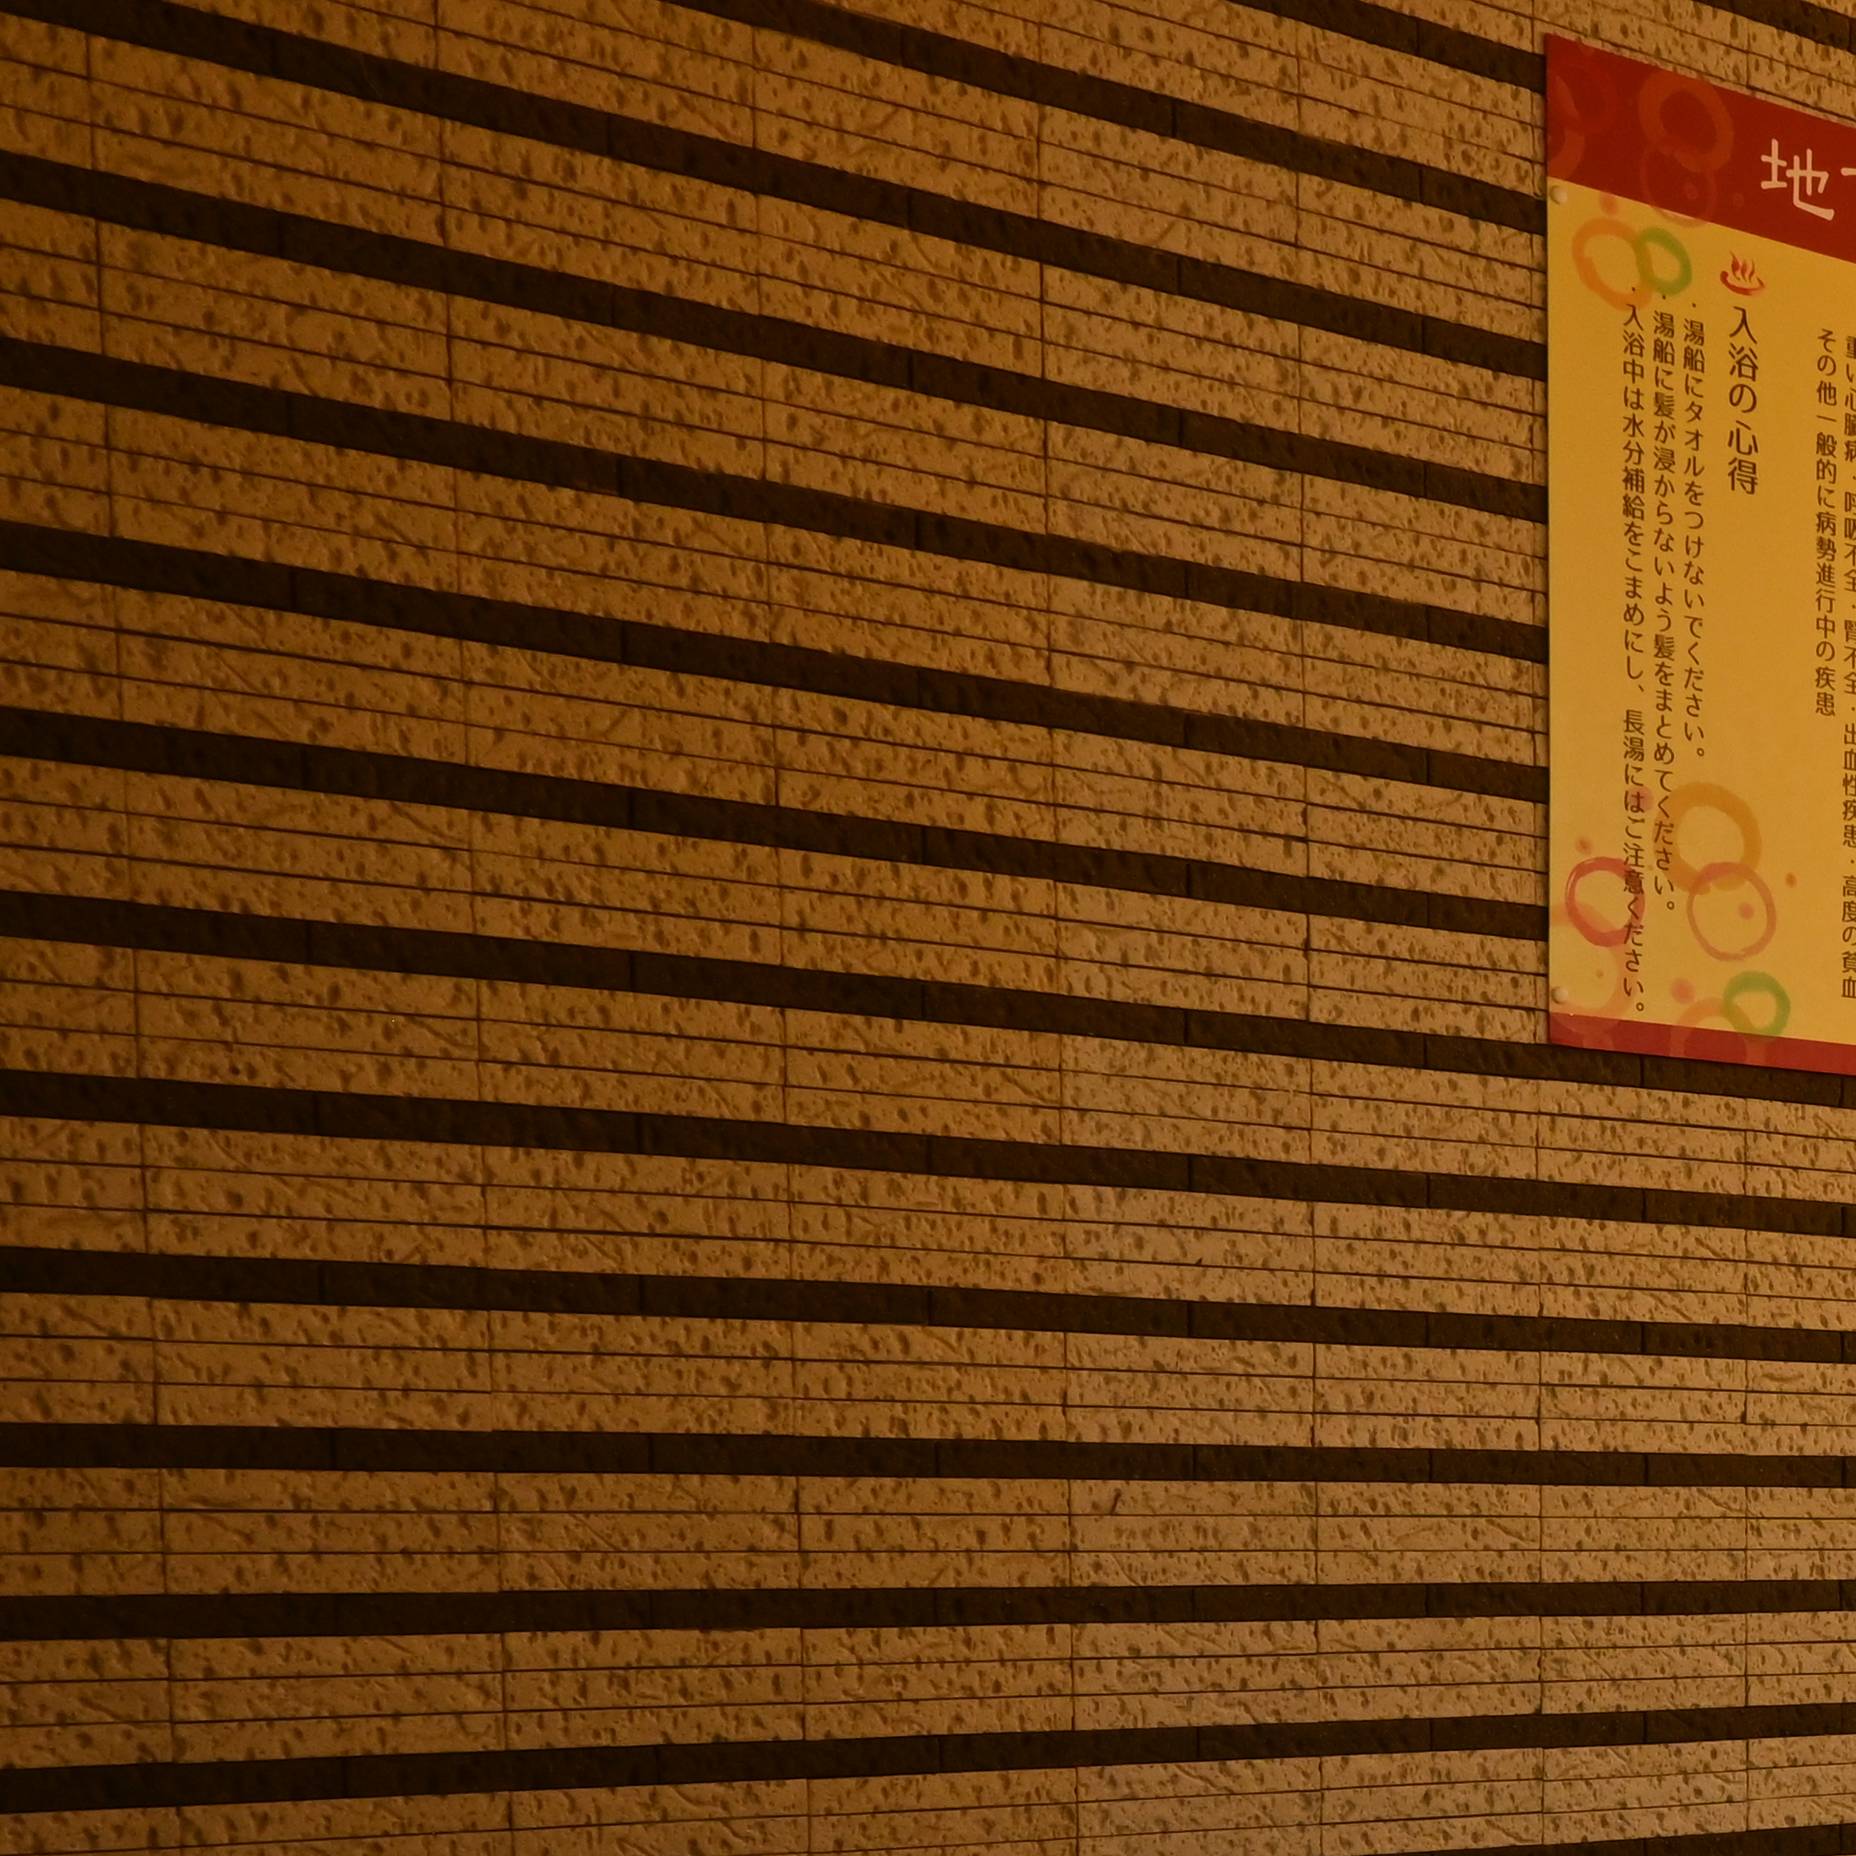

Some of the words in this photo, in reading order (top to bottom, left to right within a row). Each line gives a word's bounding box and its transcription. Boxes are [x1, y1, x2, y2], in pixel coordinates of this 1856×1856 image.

[1727, 305, 1760, 497] 入浴の心得
[1815, 328, 1838, 718] その他一般的に病勢進行中の疾患
